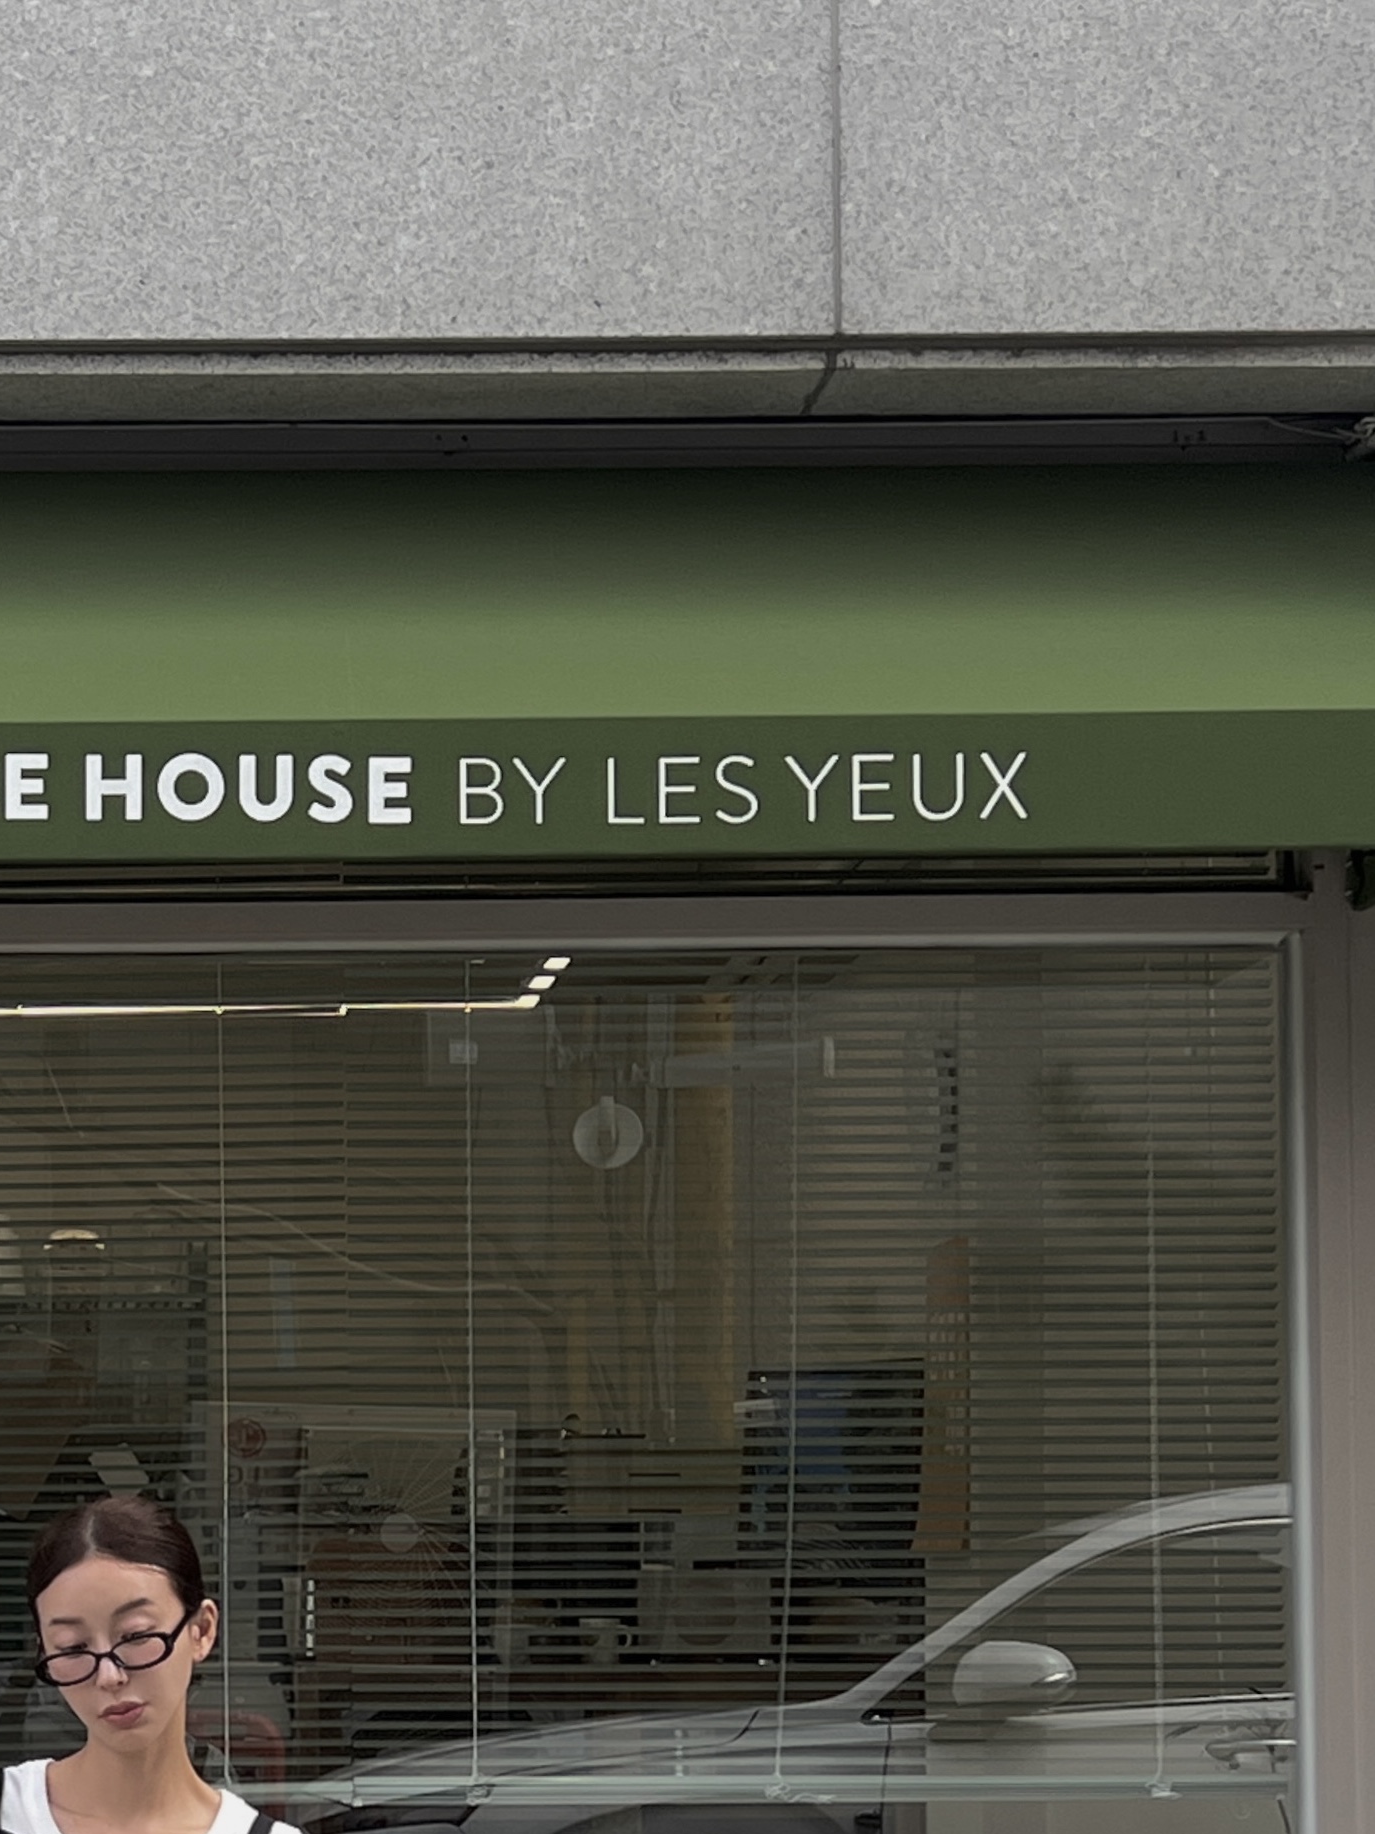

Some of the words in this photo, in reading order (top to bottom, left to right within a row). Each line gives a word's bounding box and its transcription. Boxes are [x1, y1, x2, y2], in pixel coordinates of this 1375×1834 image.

[85, 752, 412, 824] HOUSE
[459, 757, 566, 825] BY
[607, 755, 759, 824] LES
[784, 752, 1028, 823] YEUX
